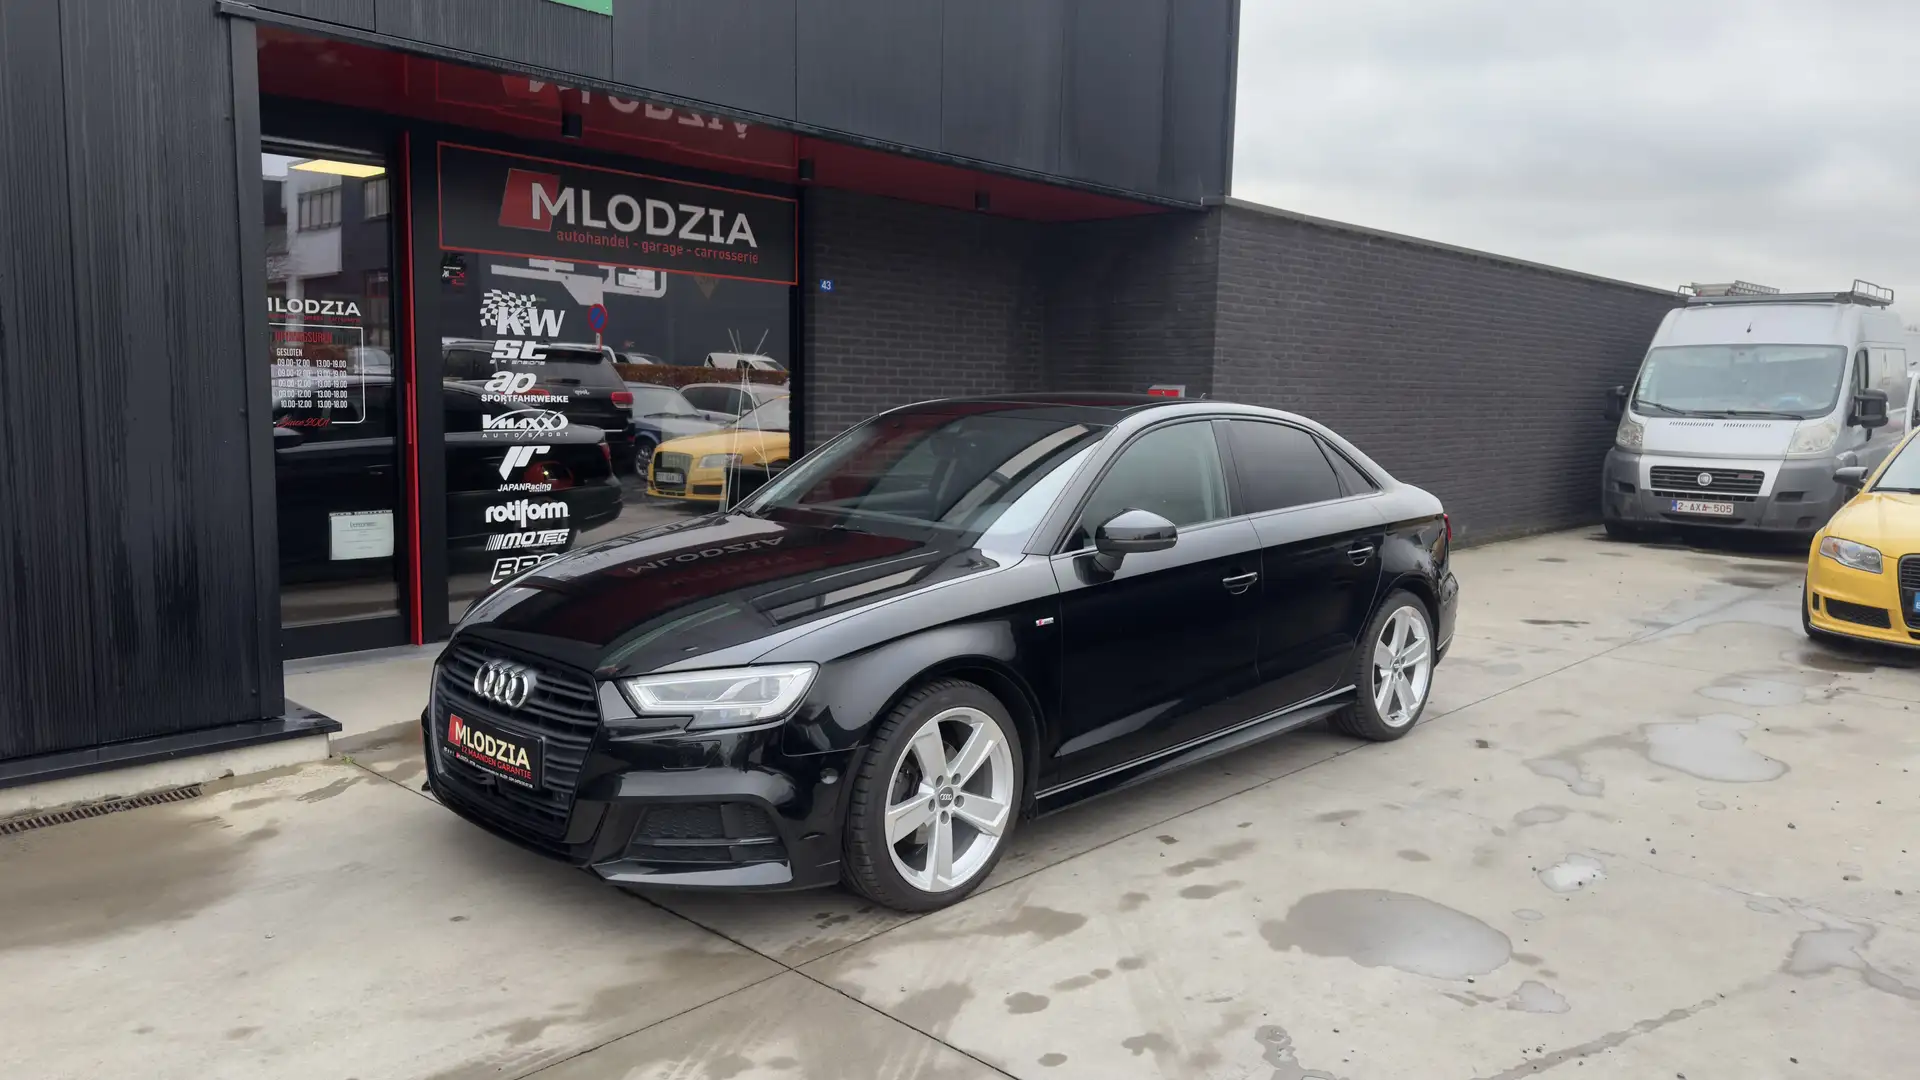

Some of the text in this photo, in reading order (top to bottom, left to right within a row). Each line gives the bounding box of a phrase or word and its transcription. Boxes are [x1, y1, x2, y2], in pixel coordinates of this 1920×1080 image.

[531, 182, 758, 248] MLODZIA
[556, 230, 629, 249] autohandel
[641, 240, 683, 256] garage
[694, 247, 760, 264] carrosserie
[821, 280, 831, 290] 43
[496, 306, 565, 337] KW
[276, 348, 303, 357] GESLOTEN
[484, 370, 537, 394] ap
[481, 394, 569, 404] SPORTFAHRWERKE
[455, 721, 531, 771] MLODZIA
[461, 744, 468, 754] 12
[468, 748, 497, 767] MAANDEN
[497, 761, 532, 779] GARANTIE
